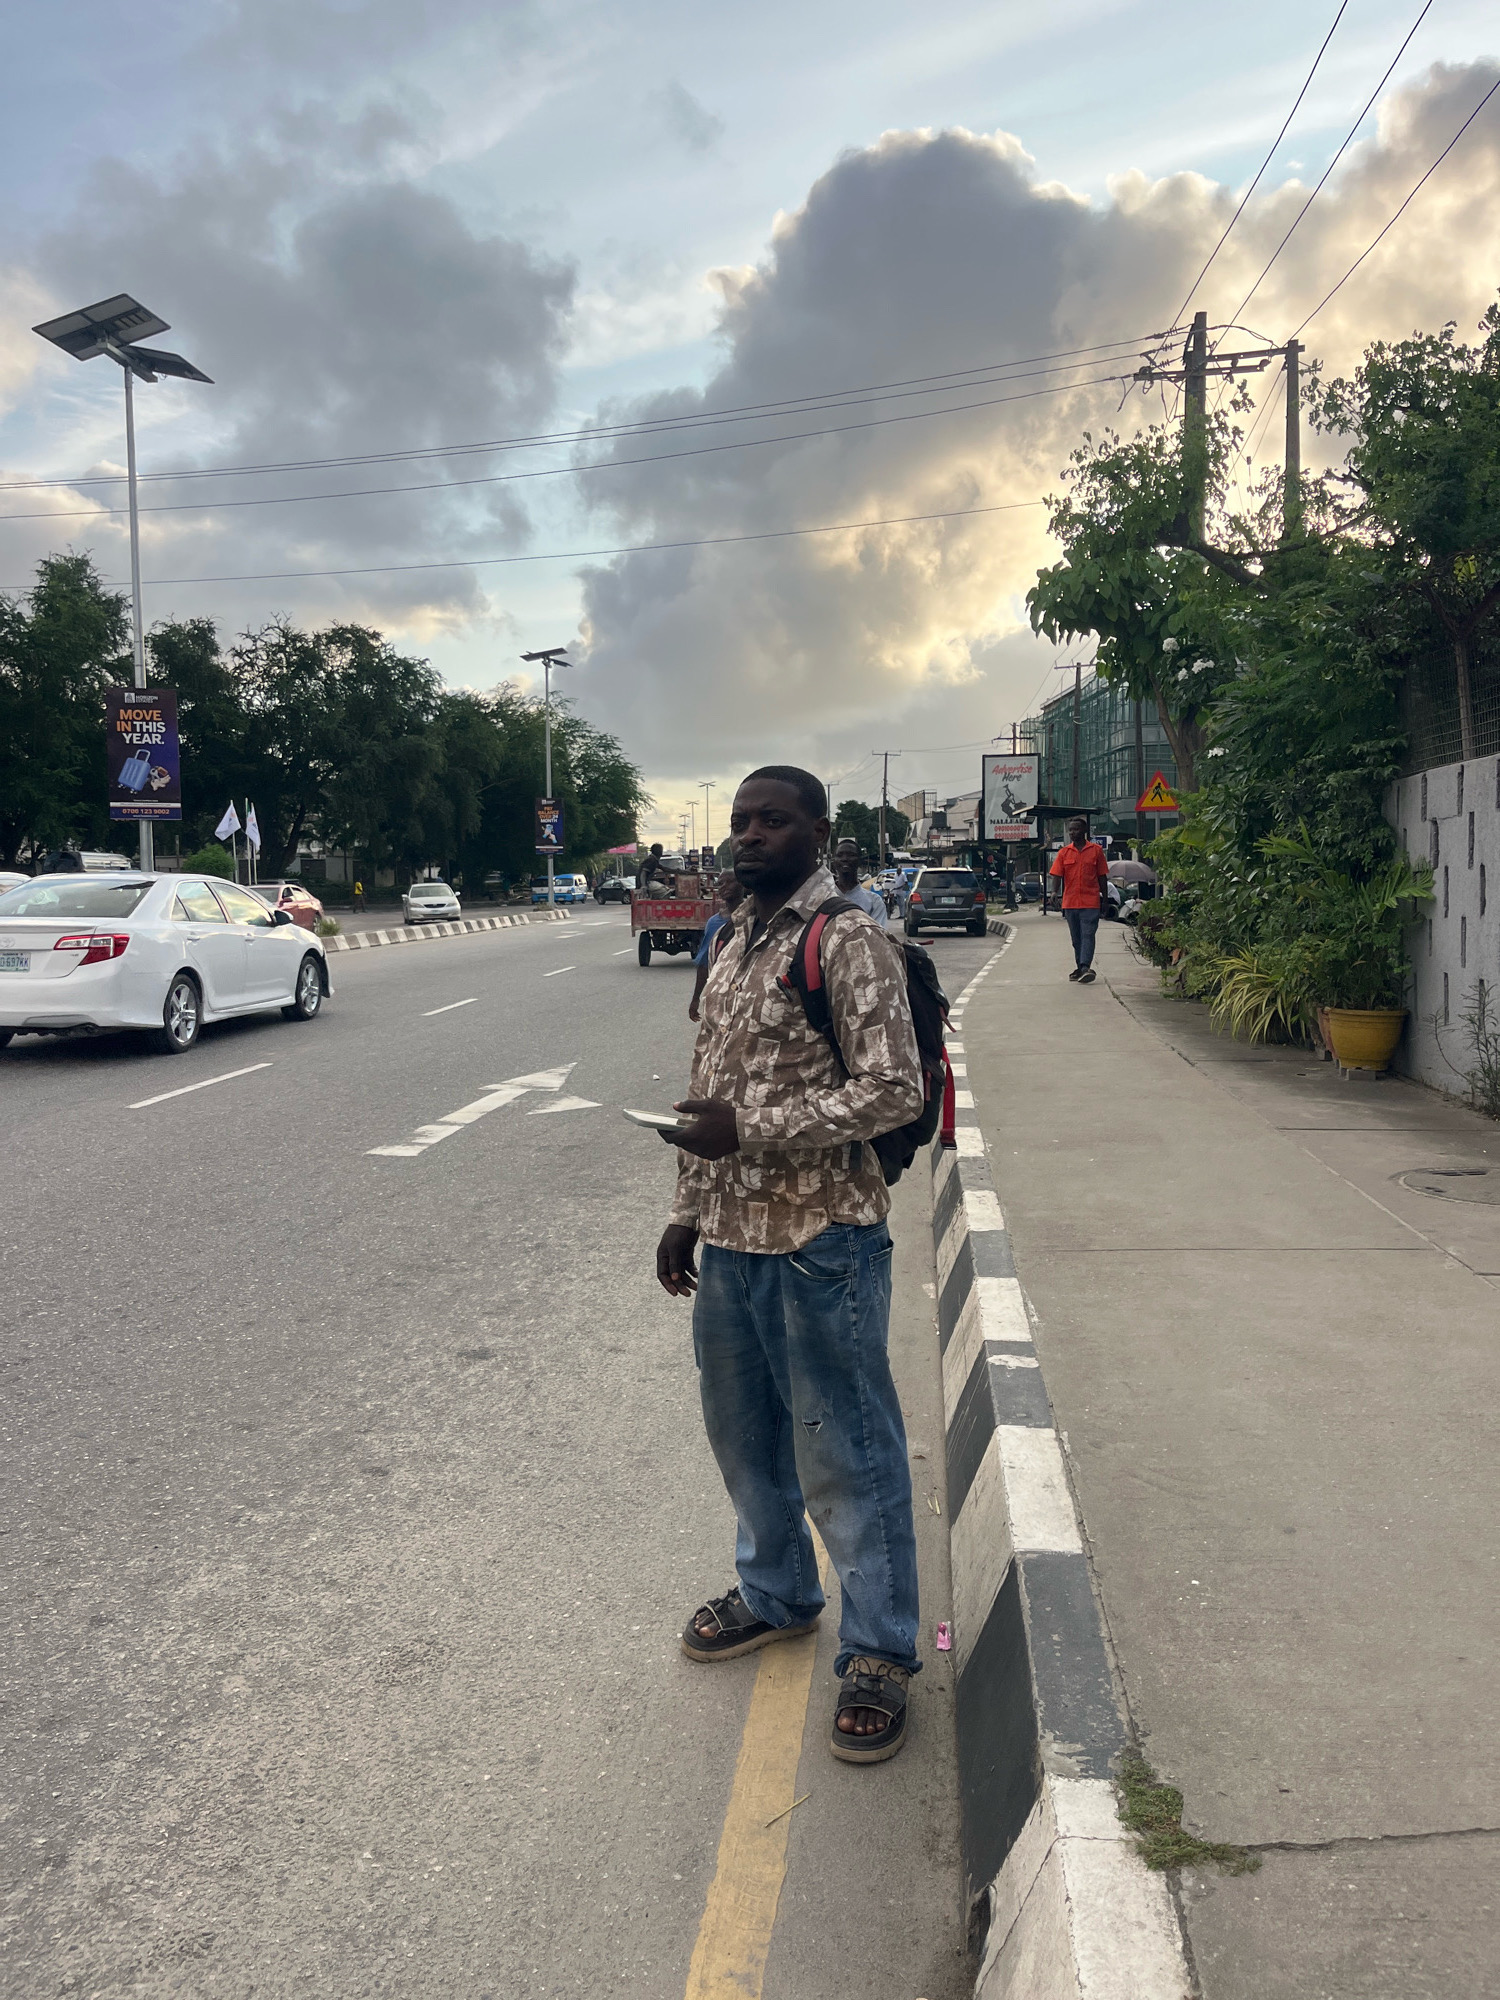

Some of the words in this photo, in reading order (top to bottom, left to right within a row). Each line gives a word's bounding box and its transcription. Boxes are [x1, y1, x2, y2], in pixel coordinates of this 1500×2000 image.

[120, 709, 162, 720] MOVE
[117, 721, 131, 732] IN
[133, 721, 166, 733] THIS
[122, 733, 165, 744] YEAR.
[992, 762, 1032, 774] Advertise
[1002, 772, 1022, 781] Here
